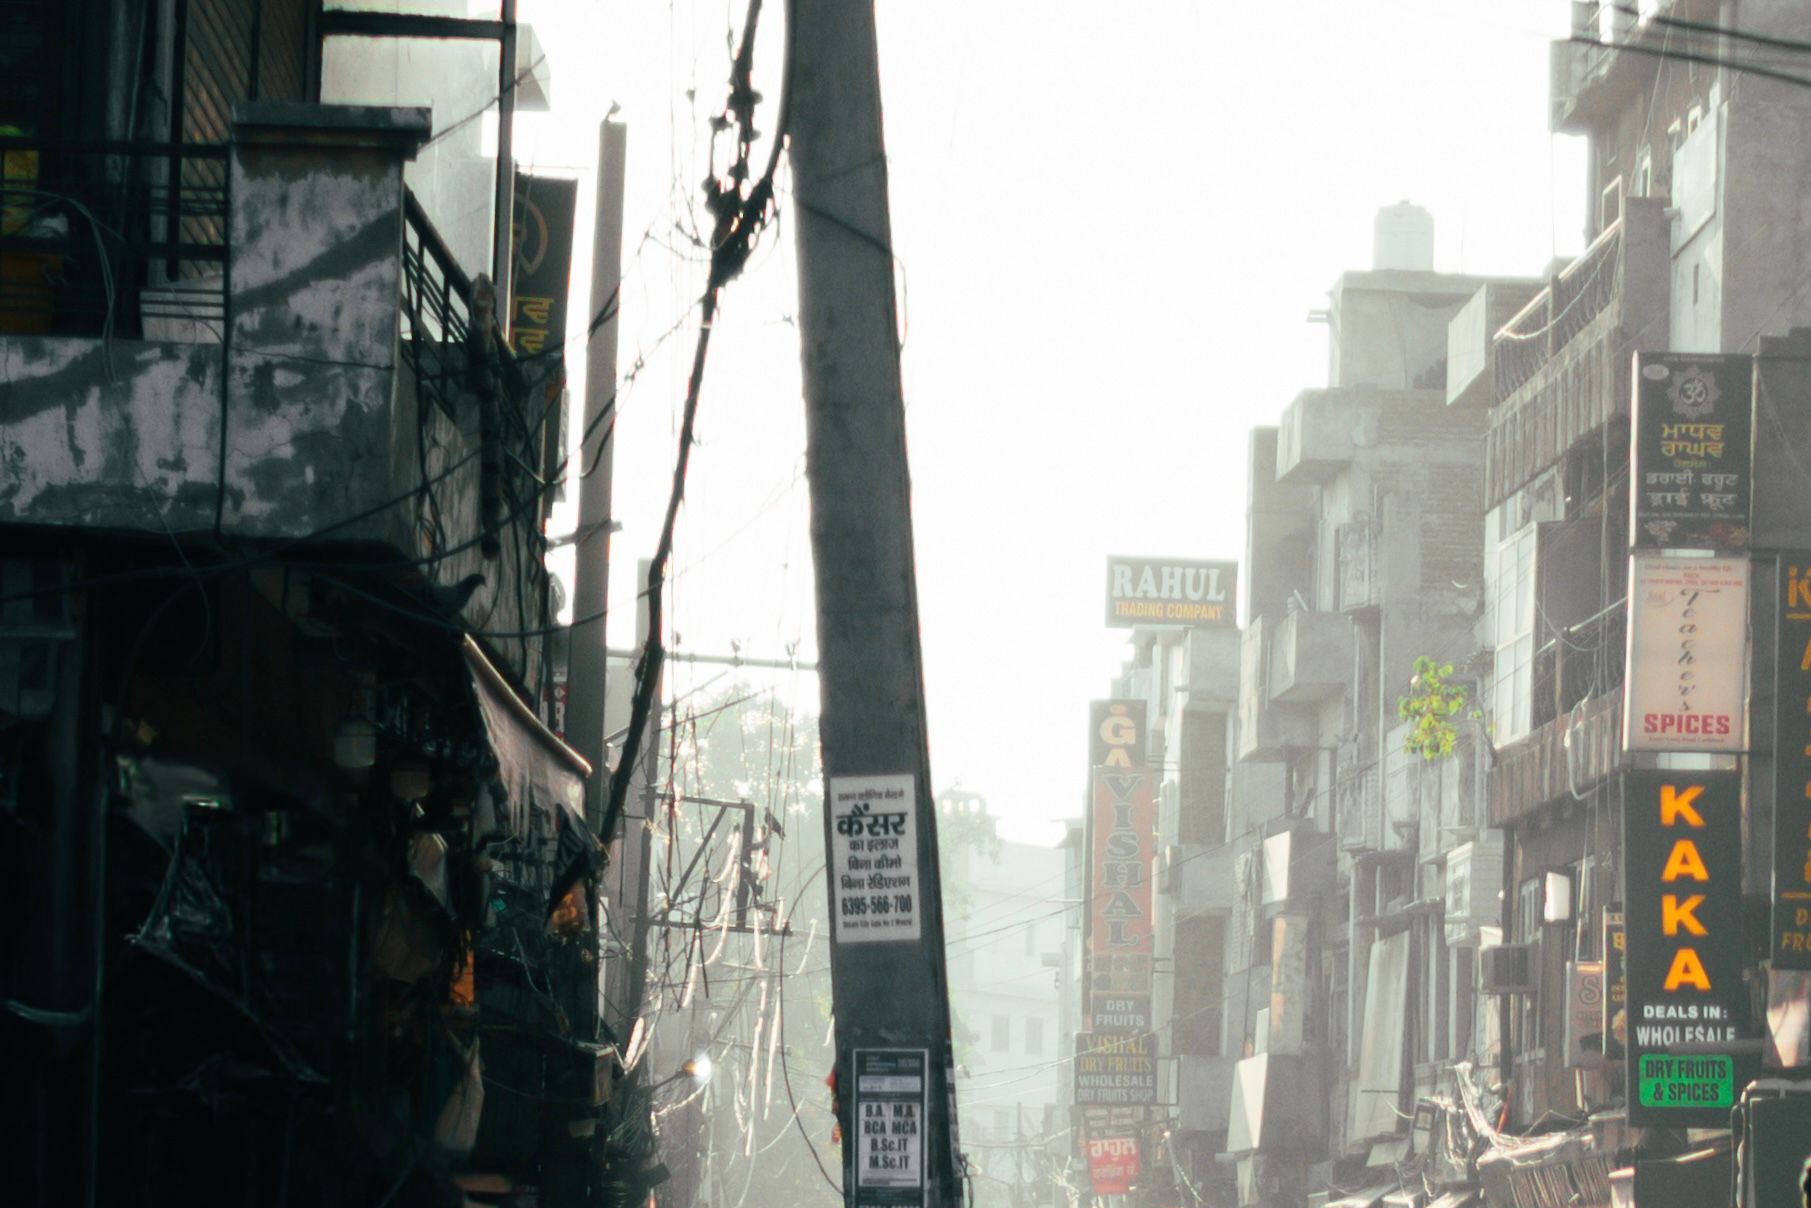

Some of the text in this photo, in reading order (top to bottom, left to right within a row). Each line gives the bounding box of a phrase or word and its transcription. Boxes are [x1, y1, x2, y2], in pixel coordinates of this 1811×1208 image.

[1111, 564, 1226, 601] RAHUL
[1115, 600, 1224, 620] TRADING COMPANY
[1644, 713, 1730, 735] SPICES
[835, 802, 908, 838] कैंसर
[849, 838, 899, 853] का इलाज
[1103, 773, 1145, 947] VISHAL
[1660, 784, 1712, 991] KAKA
[841, 893, 912, 916] 6395-566-700
[1106, 999, 1135, 1012] DRY
[1643, 1005, 1728, 1020] DEALS IN:
[1095, 1014, 1145, 1027] FRUITS
[1086, 1035, 1148, 1055] VISHAL
[1080, 1057, 1152, 1073] DRY FRUITS
[1644, 1057, 1727, 1080] DRY FRUITS
[1078, 1075, 1153, 1087] WHOLESALE
[1097, 1089, 1128, 1103] FRUITS
[1653, 1083, 1720, 1102] & SPICES
[866, 1103, 886, 1118] B.A.
[865, 1120, 918, 1135] BCA MCA
